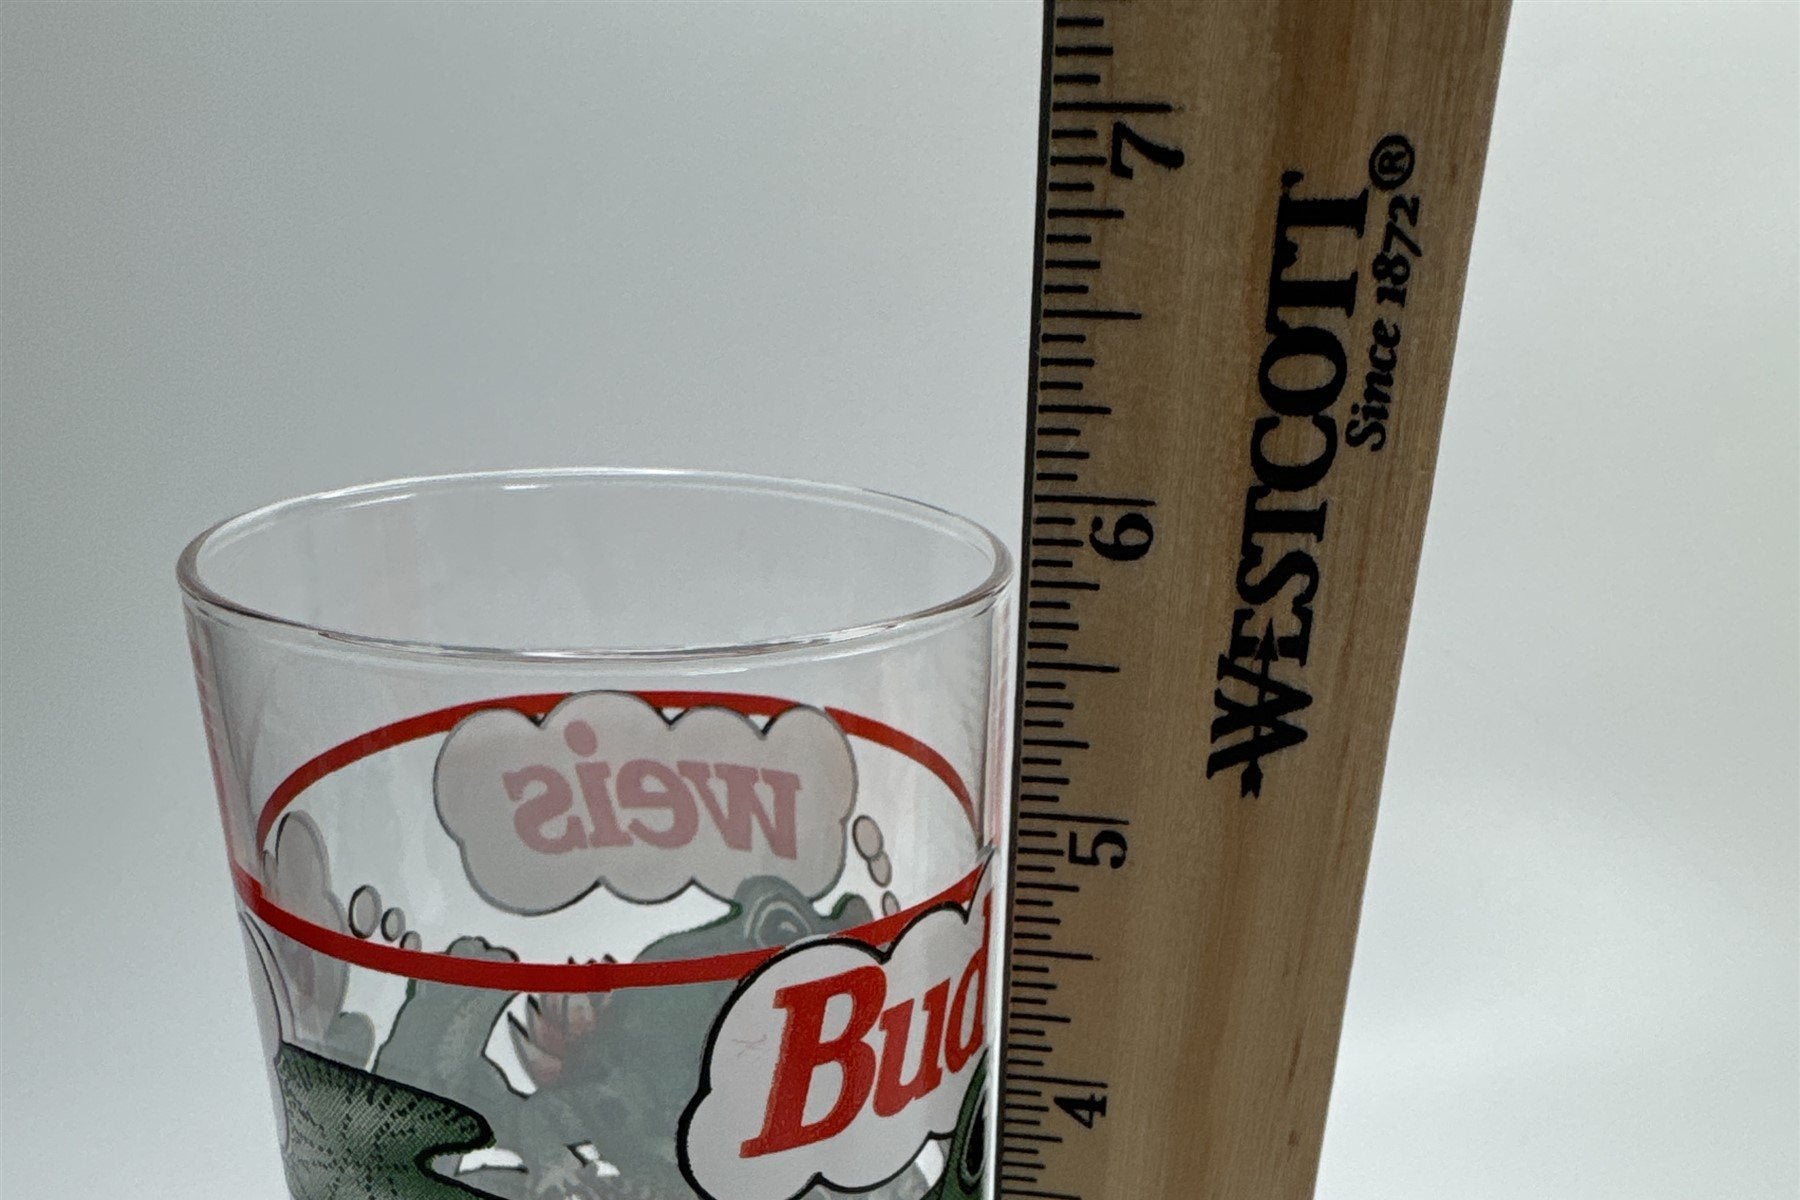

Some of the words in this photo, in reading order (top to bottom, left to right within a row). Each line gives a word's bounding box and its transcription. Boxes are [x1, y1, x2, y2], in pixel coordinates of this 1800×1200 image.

[1111, 121, 1185, 181] 7
[1346, 318, 1402, 451] Since
[1206, 170, 1370, 785] WESTCOTT
[1088, 512, 1154, 562] 6
[1068, 829, 1128, 869] 5
[738, 888, 992, 1159] Bud
[1053, 1093, 1108, 1129] 4
